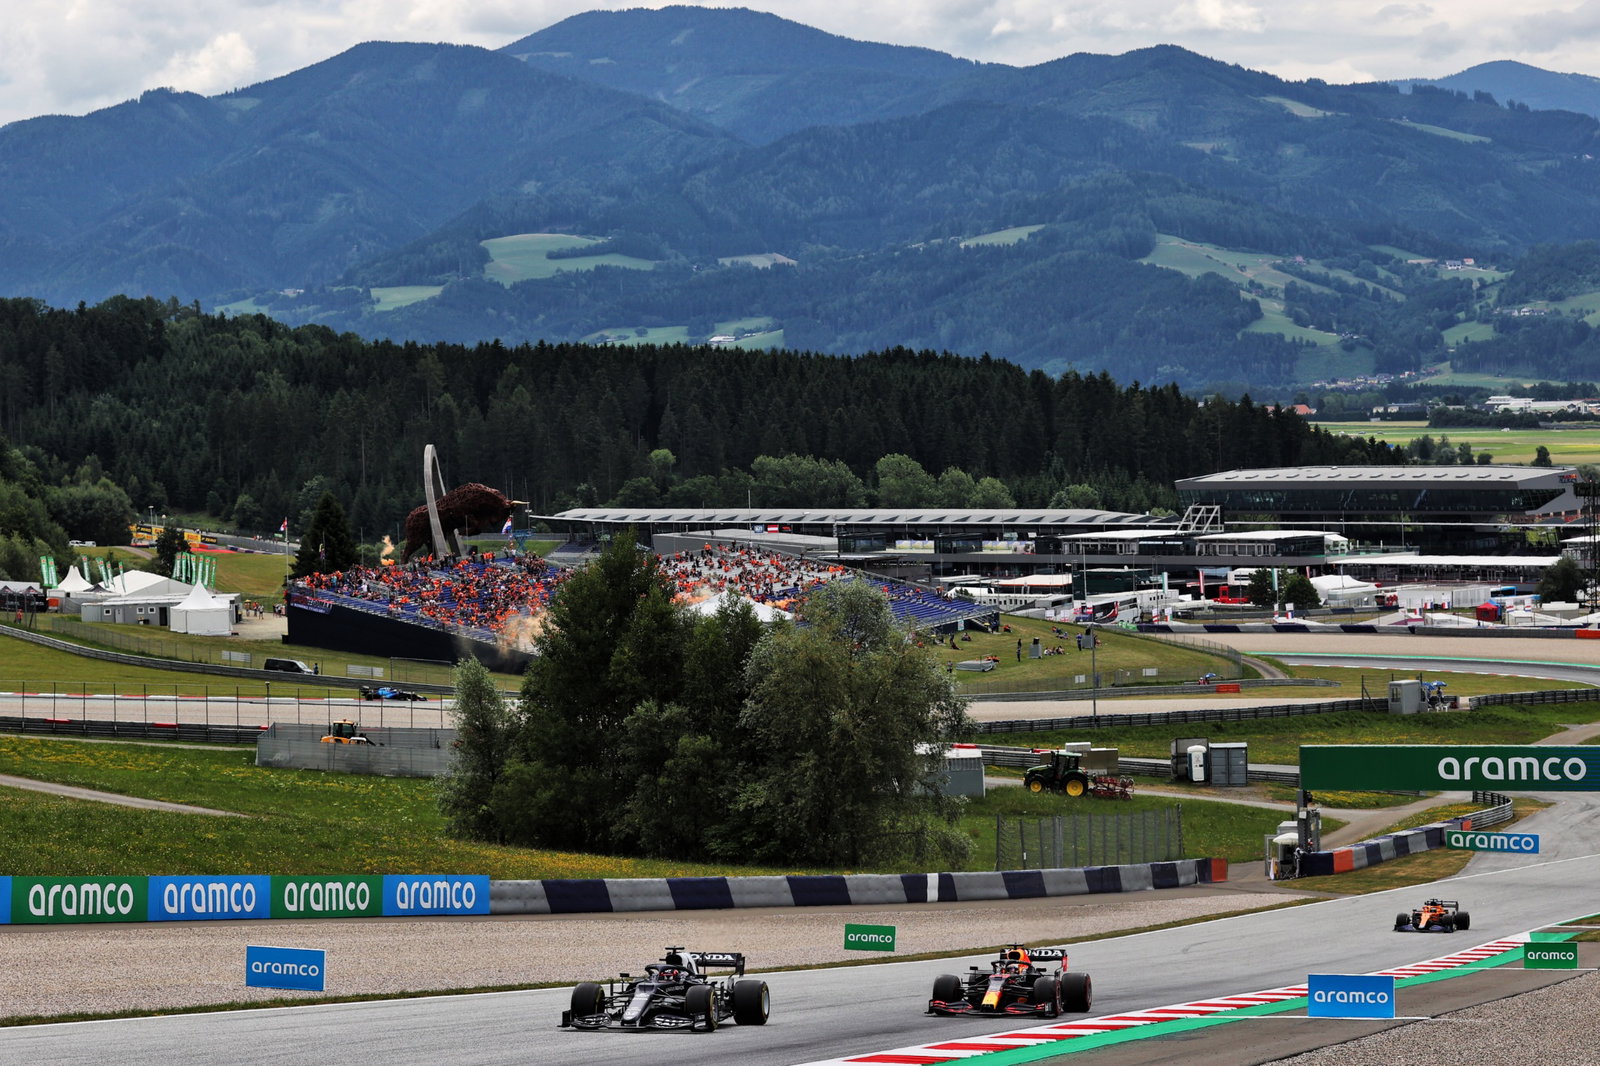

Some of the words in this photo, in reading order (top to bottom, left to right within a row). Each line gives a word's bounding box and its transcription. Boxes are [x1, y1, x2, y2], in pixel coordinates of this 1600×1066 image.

[1437, 756, 1587, 781] aramco
[1450, 833, 1535, 851] aramco
[28, 882, 134, 917] aramco
[163, 882, 256, 914] aramco
[284, 881, 370, 912] aramco
[396, 880, 476, 909] aramco
[848, 934, 892, 942] aramco
[1527, 950, 1575, 961] aramco
[251, 961, 319, 977] aramco
[1314, 990, 1388, 1004] aramco
